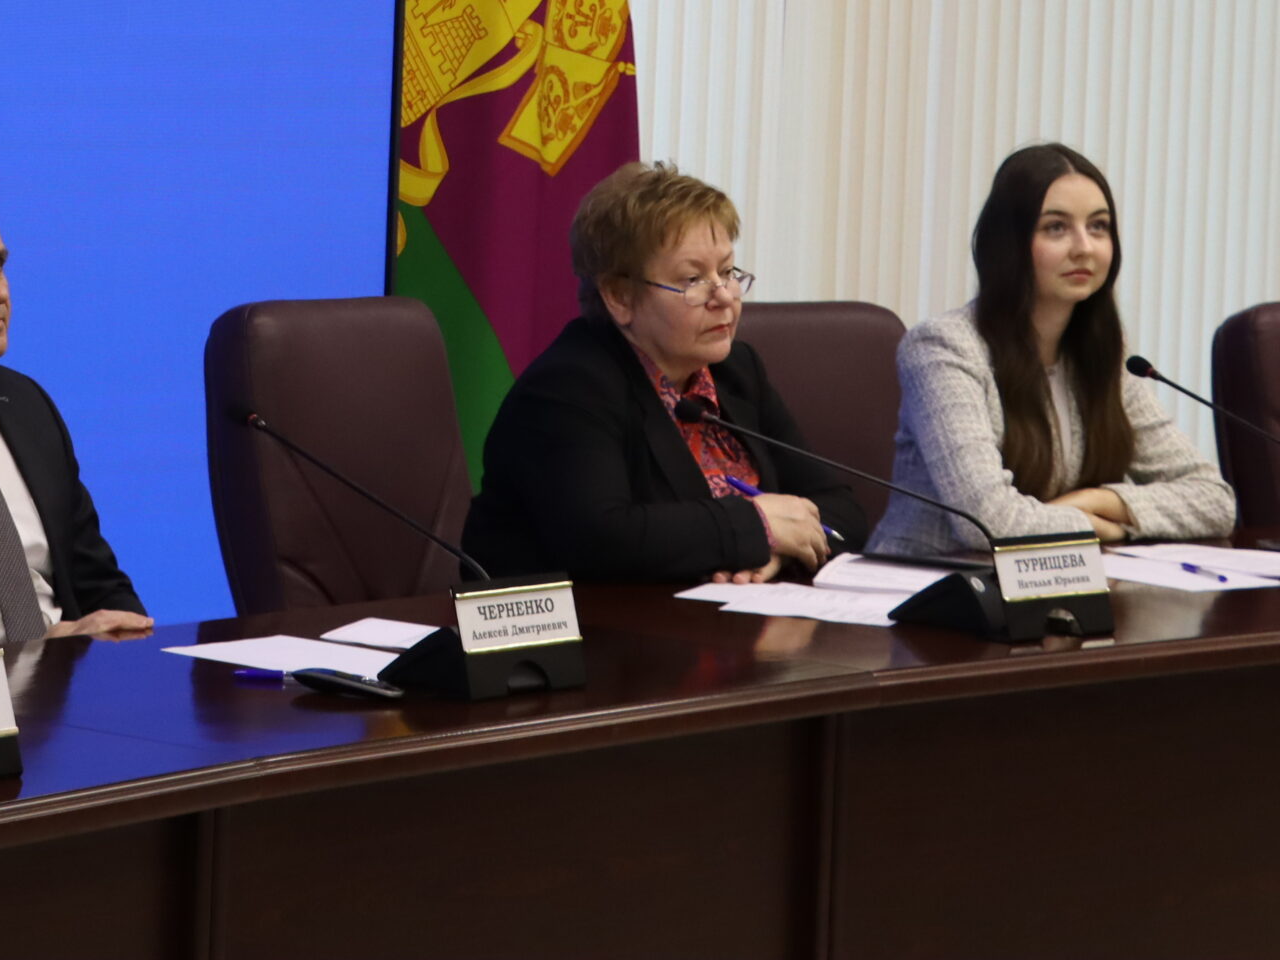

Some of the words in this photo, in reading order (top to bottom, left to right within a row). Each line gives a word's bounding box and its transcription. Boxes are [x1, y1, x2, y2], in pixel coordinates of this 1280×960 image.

[1015, 554, 1086, 573] ТУРИЩЕВА
[478, 598, 554, 620] ЧЕРНЕНКО
[472, 628, 508, 640] Алексей
[512, 621, 567, 636] Дмитриевич
